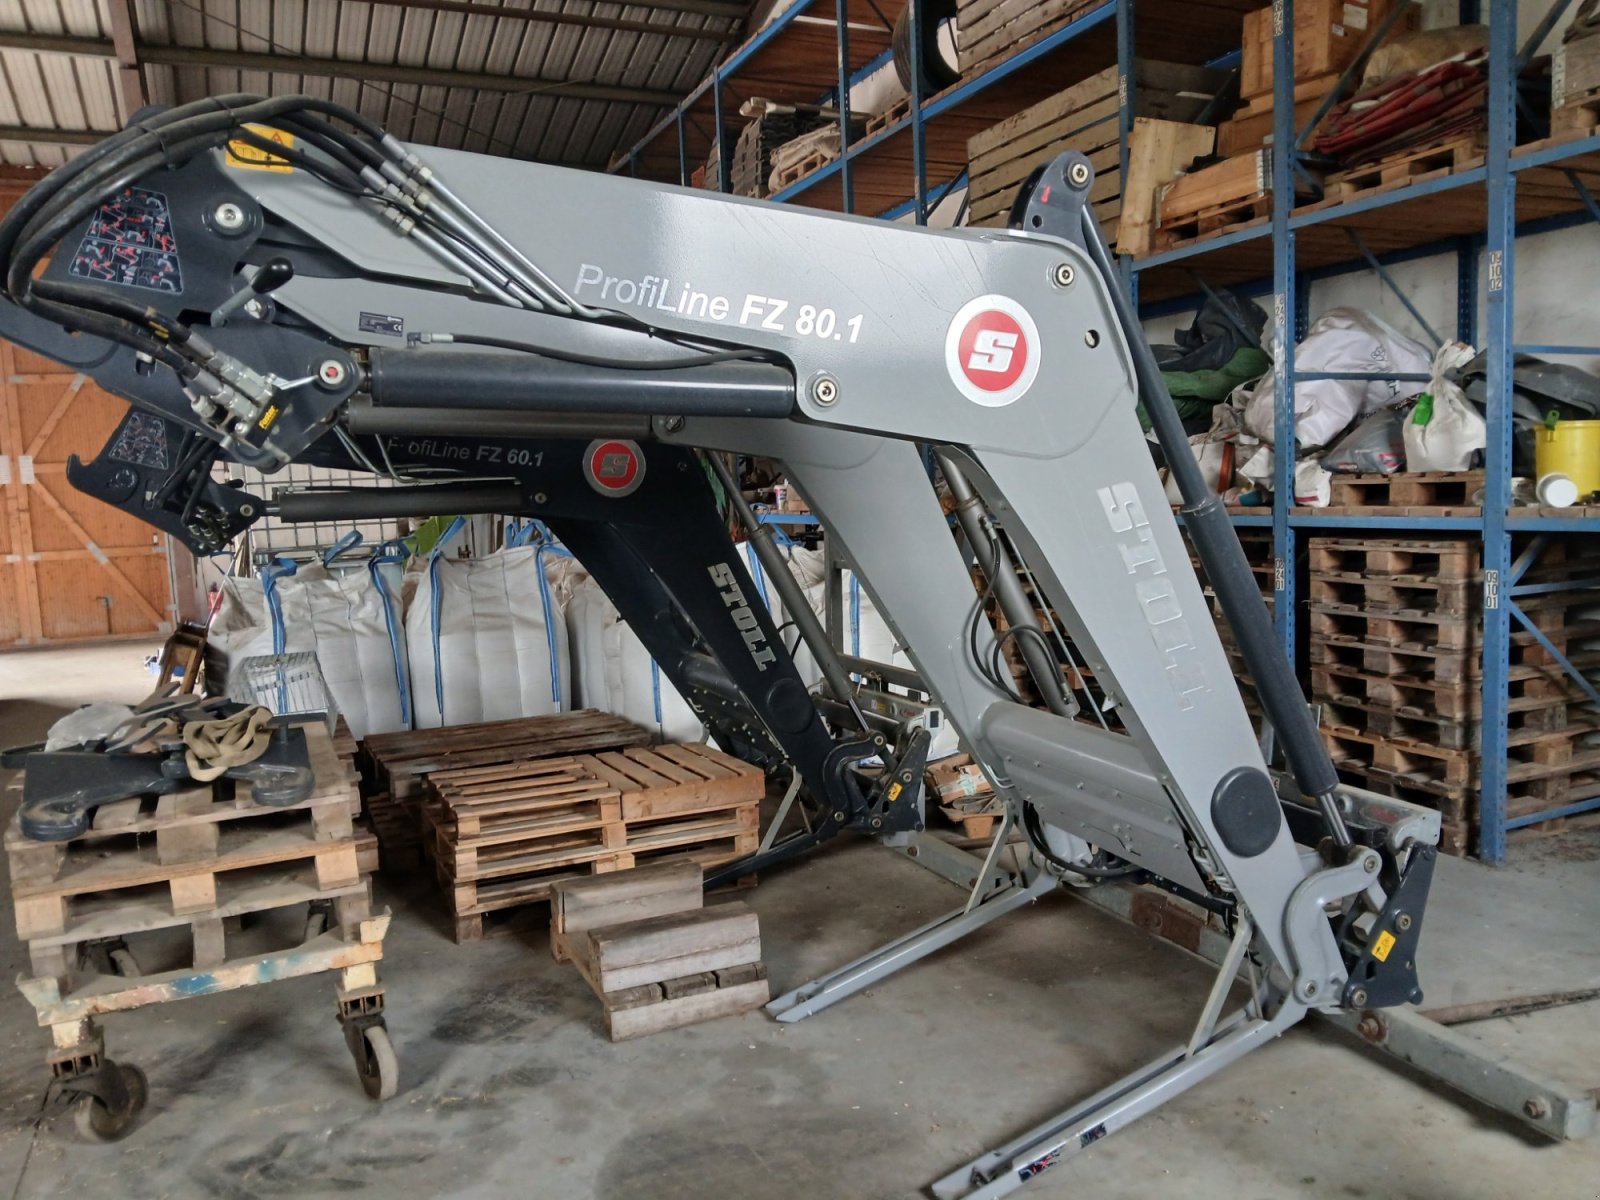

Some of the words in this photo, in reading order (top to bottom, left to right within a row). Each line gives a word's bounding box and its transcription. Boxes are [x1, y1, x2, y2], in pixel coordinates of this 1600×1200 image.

[1490, 265, 1502, 278] 10
[1490, 278, 1502, 290] 02
[572, 262, 730, 322] ProfiLine
[739, 293, 789, 332] FZ
[795, 304, 864, 344] 80.1
[967, 328, 1019, 373] S
[258, 404, 278, 430] Faster
[387, 436, 470, 460] PofiLine
[476, 444, 503, 463] FZ
[507, 448, 544, 468] 60.1
[599, 453, 631, 478] S
[1275, 569, 1284, 580] 24
[1486, 571, 1498, 583] 09
[1275, 579, 1284, 590] 01
[1487, 583, 1498, 596] 10
[1096, 481, 1213, 712] STOLL
[1486, 595, 1498, 608] 01
[706, 562, 777, 672] STOLL
